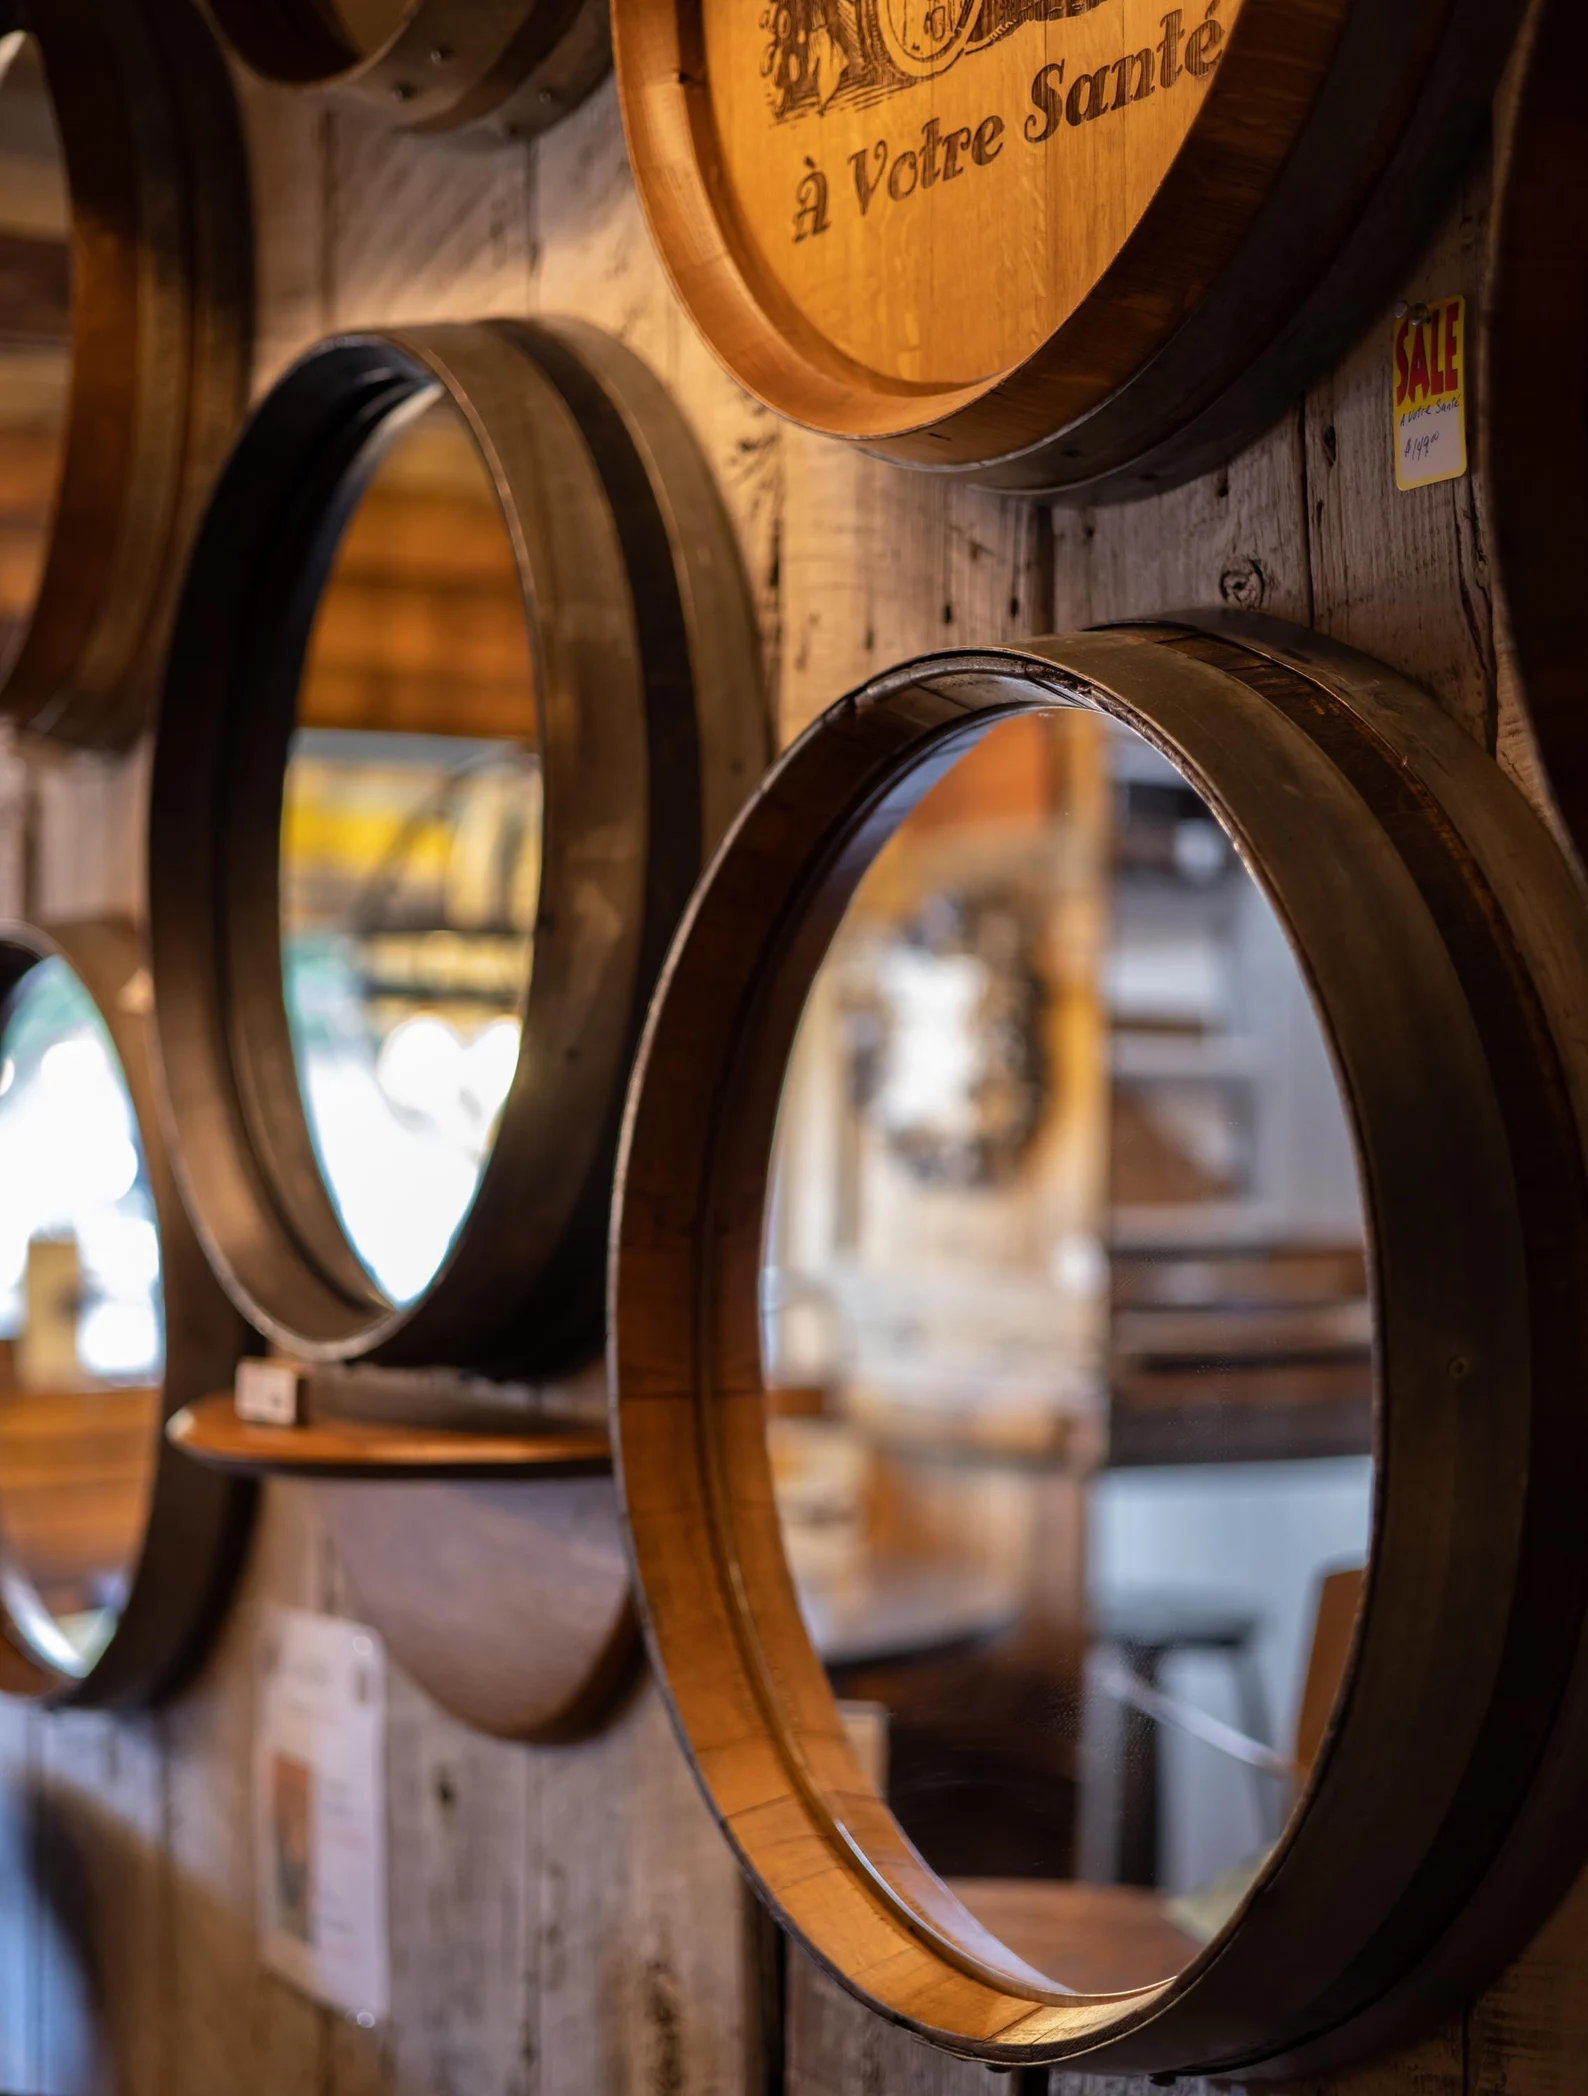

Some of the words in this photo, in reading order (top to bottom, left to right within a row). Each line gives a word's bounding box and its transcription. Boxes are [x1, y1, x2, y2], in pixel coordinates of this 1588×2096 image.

[847, 115, 1005, 216] Votre
[1024, 0, 1225, 143] Santé
[1396, 302, 1460, 407] SALE
[1408, 404, 1432, 423] Votre
[1435, 394, 1461, 414] Santé
